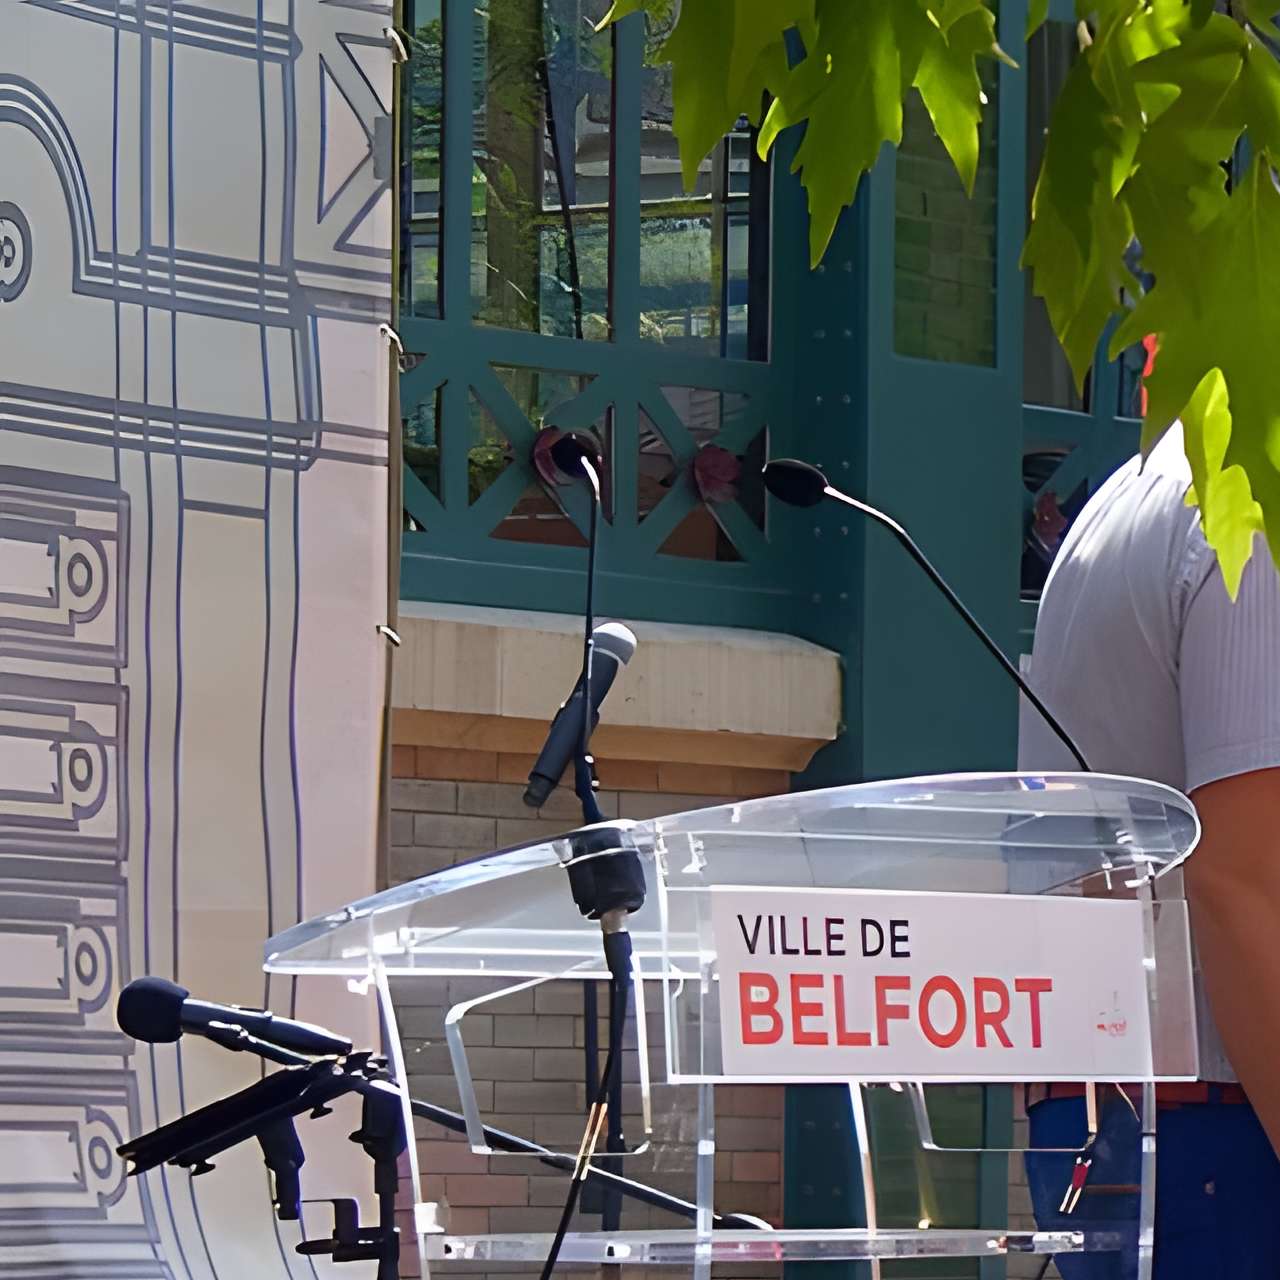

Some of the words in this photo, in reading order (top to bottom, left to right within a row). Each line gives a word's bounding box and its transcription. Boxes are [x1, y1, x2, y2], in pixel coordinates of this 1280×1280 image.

[737, 914, 846, 957] VILLE
[860, 918, 912, 958] DE
[738, 971, 1054, 1050] BELFORT
